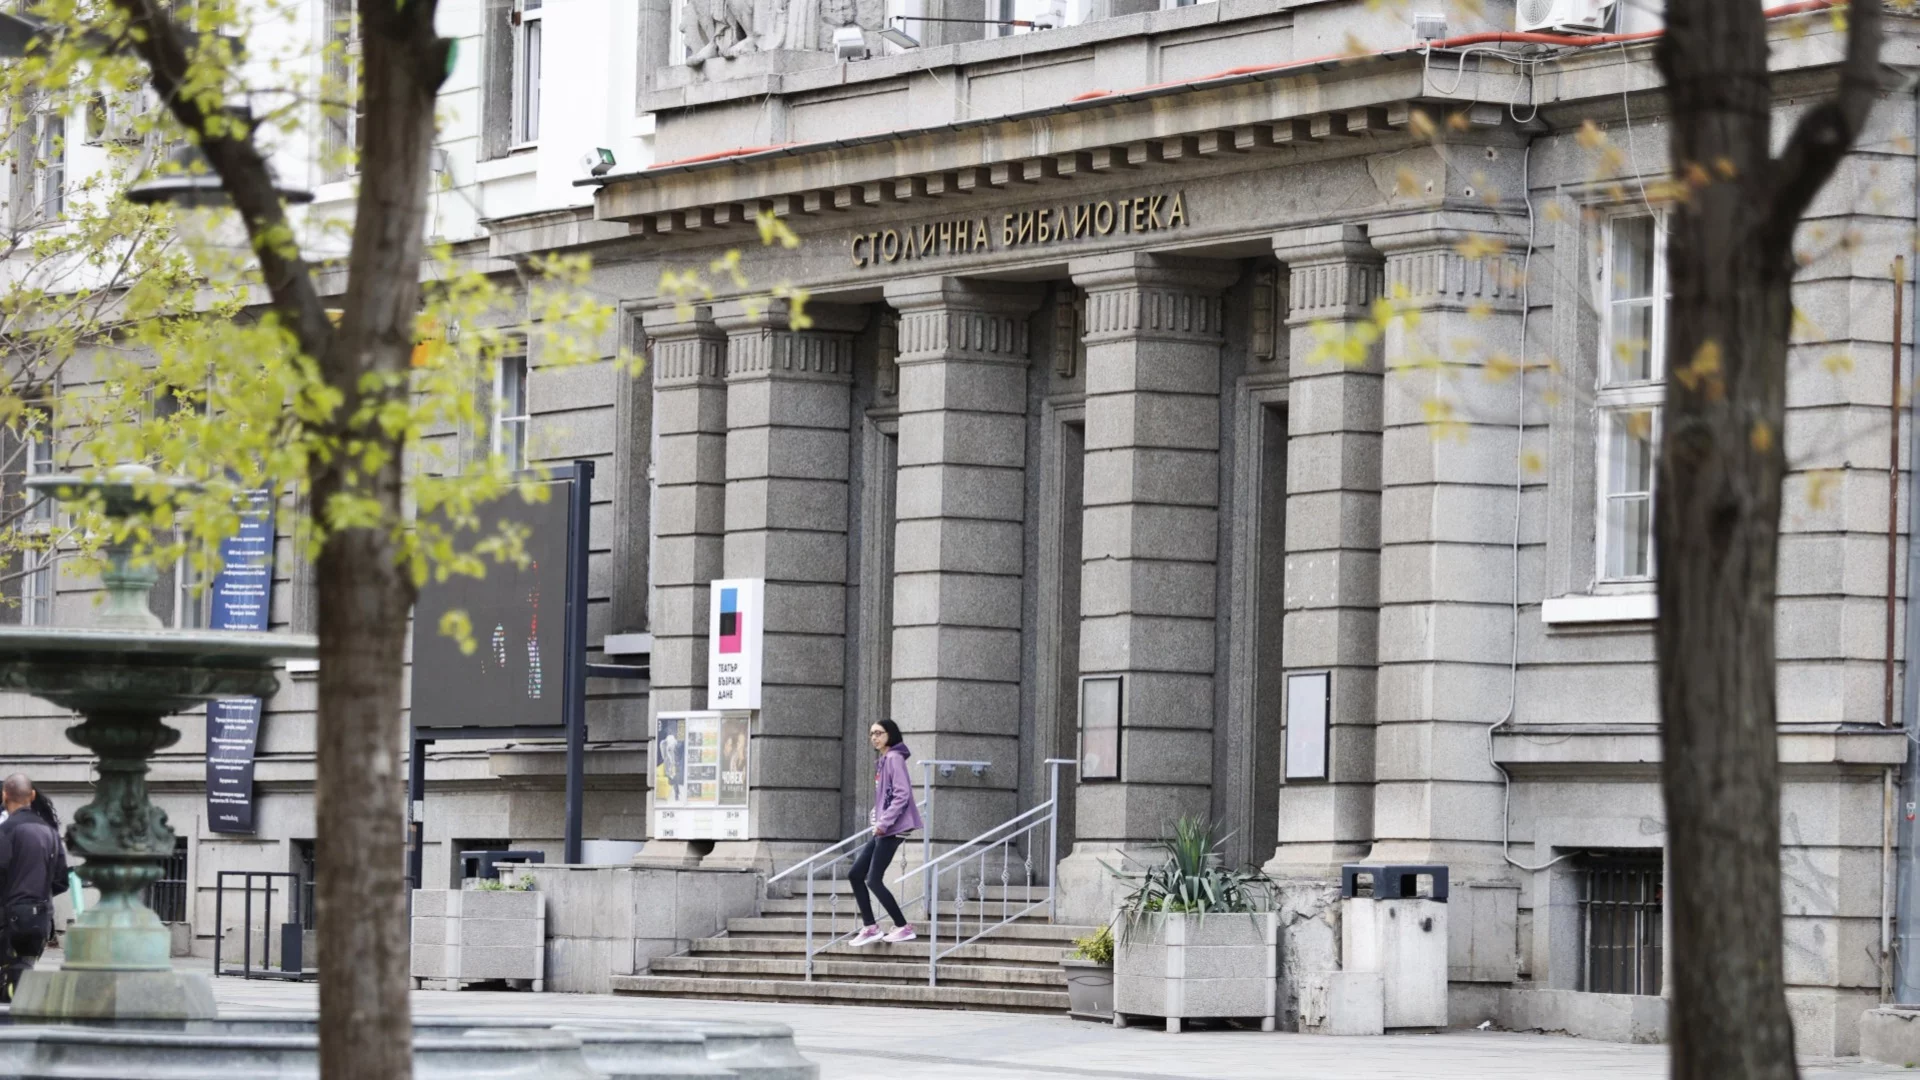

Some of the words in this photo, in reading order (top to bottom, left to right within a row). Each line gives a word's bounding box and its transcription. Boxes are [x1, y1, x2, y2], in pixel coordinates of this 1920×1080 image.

[851, 216, 992, 268] СТОЛИЧНА
[1002, 190, 1189, 246] БИБЛИОТЕКА
[718, 663, 738, 673] ТЕАТЪР
[717, 689, 733, 700] ДАНЕ
